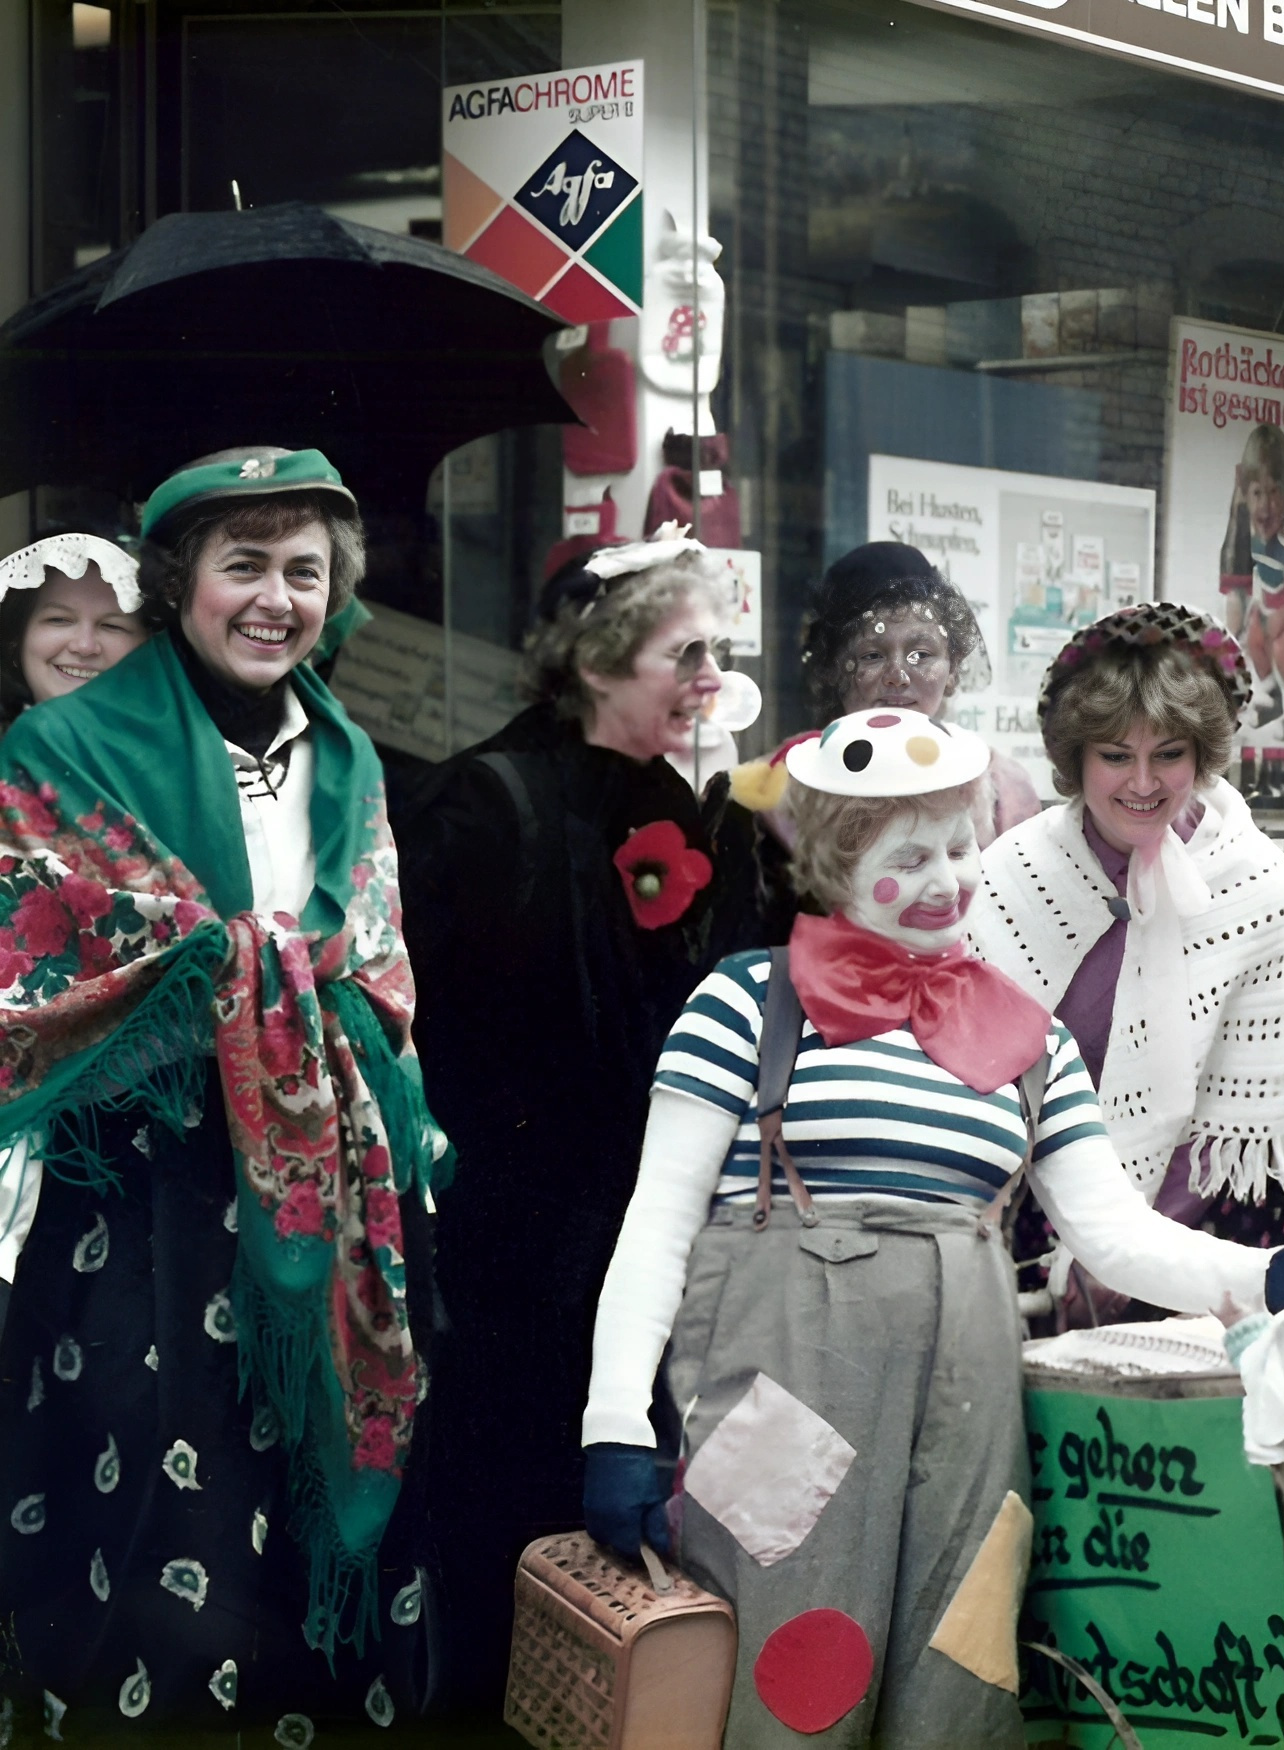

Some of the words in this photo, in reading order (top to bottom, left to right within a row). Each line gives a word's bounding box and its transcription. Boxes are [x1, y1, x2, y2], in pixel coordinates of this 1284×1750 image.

[449, 68, 634, 122] AGFACHROME
[530, 159, 615, 228] Agfa
[1179, 382, 1209, 415] ist
[887, 488, 913, 516] Bei
[1058, 1405, 1206, 1499] gehen
[1083, 1507, 1151, 1572] die
